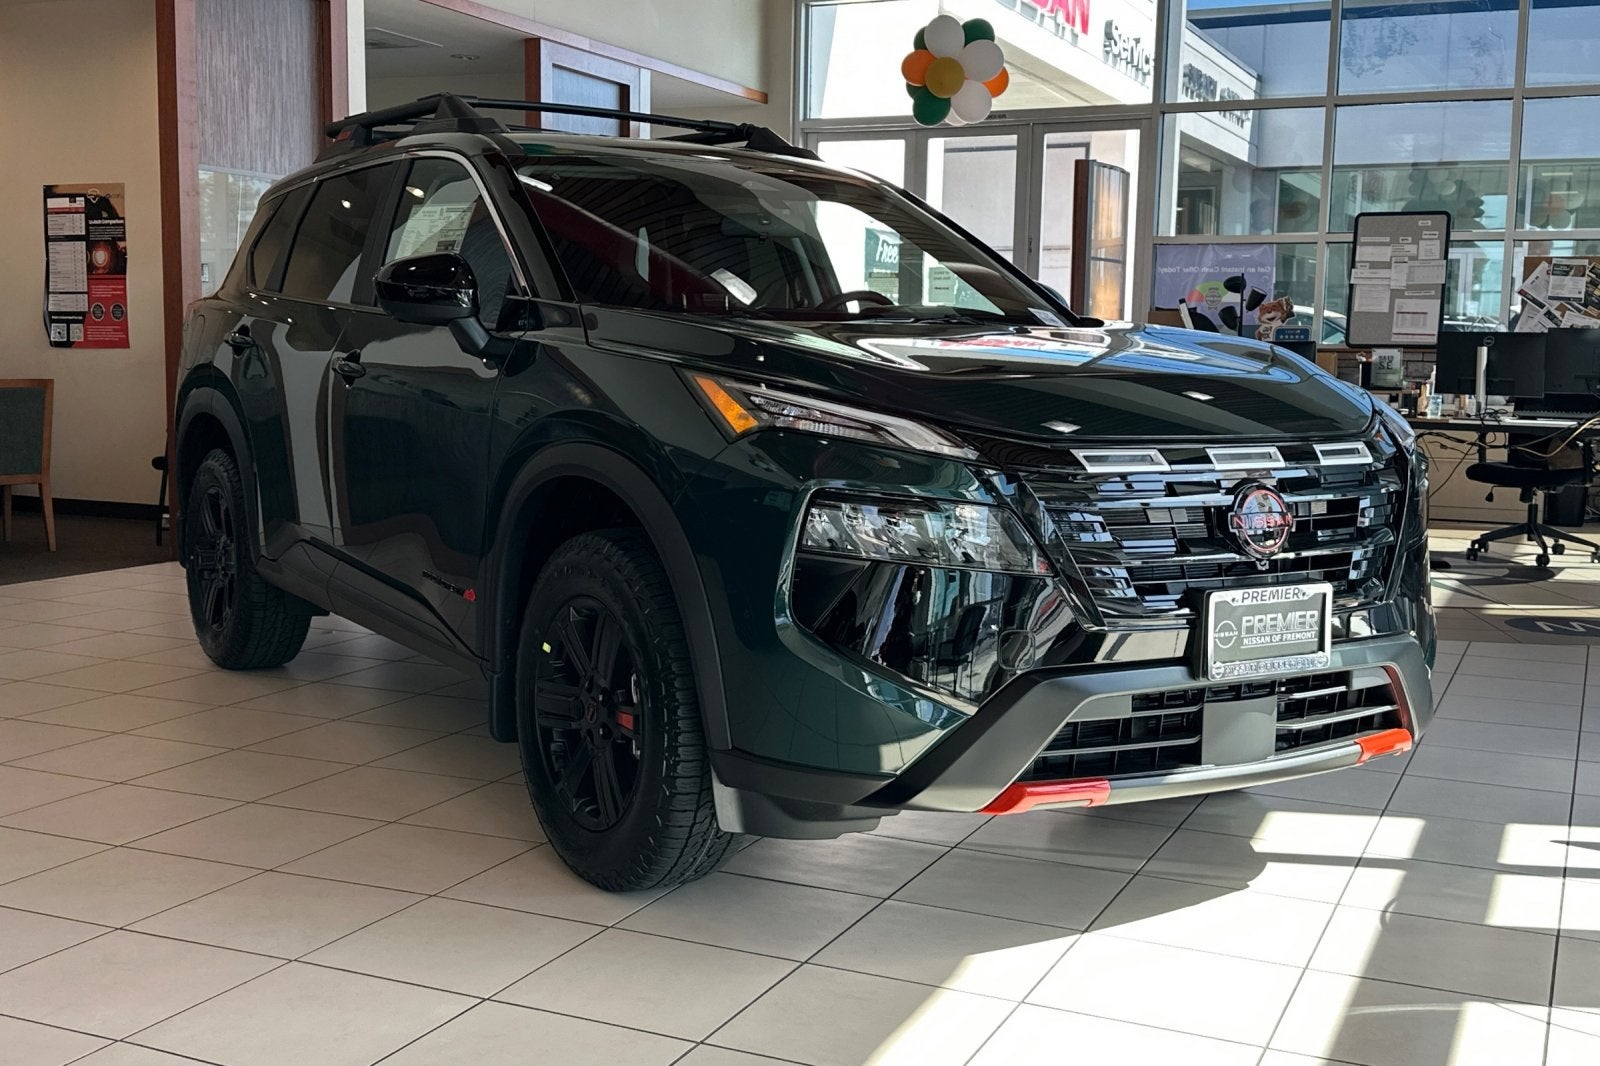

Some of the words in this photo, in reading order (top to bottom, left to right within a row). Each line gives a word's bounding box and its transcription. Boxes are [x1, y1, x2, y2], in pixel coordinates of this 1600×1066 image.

[1232, 512, 1293, 529] NISSAN
[1241, 587, 1301, 603] PREMIER
[1241, 610, 1319, 635] PREMIER
[1214, 630, 1239, 638] NISSAN
[1243, 634, 1270, 645] NISSAN
[1271, 634, 1281, 643] OF
[1282, 631, 1316, 641] FREMONT
